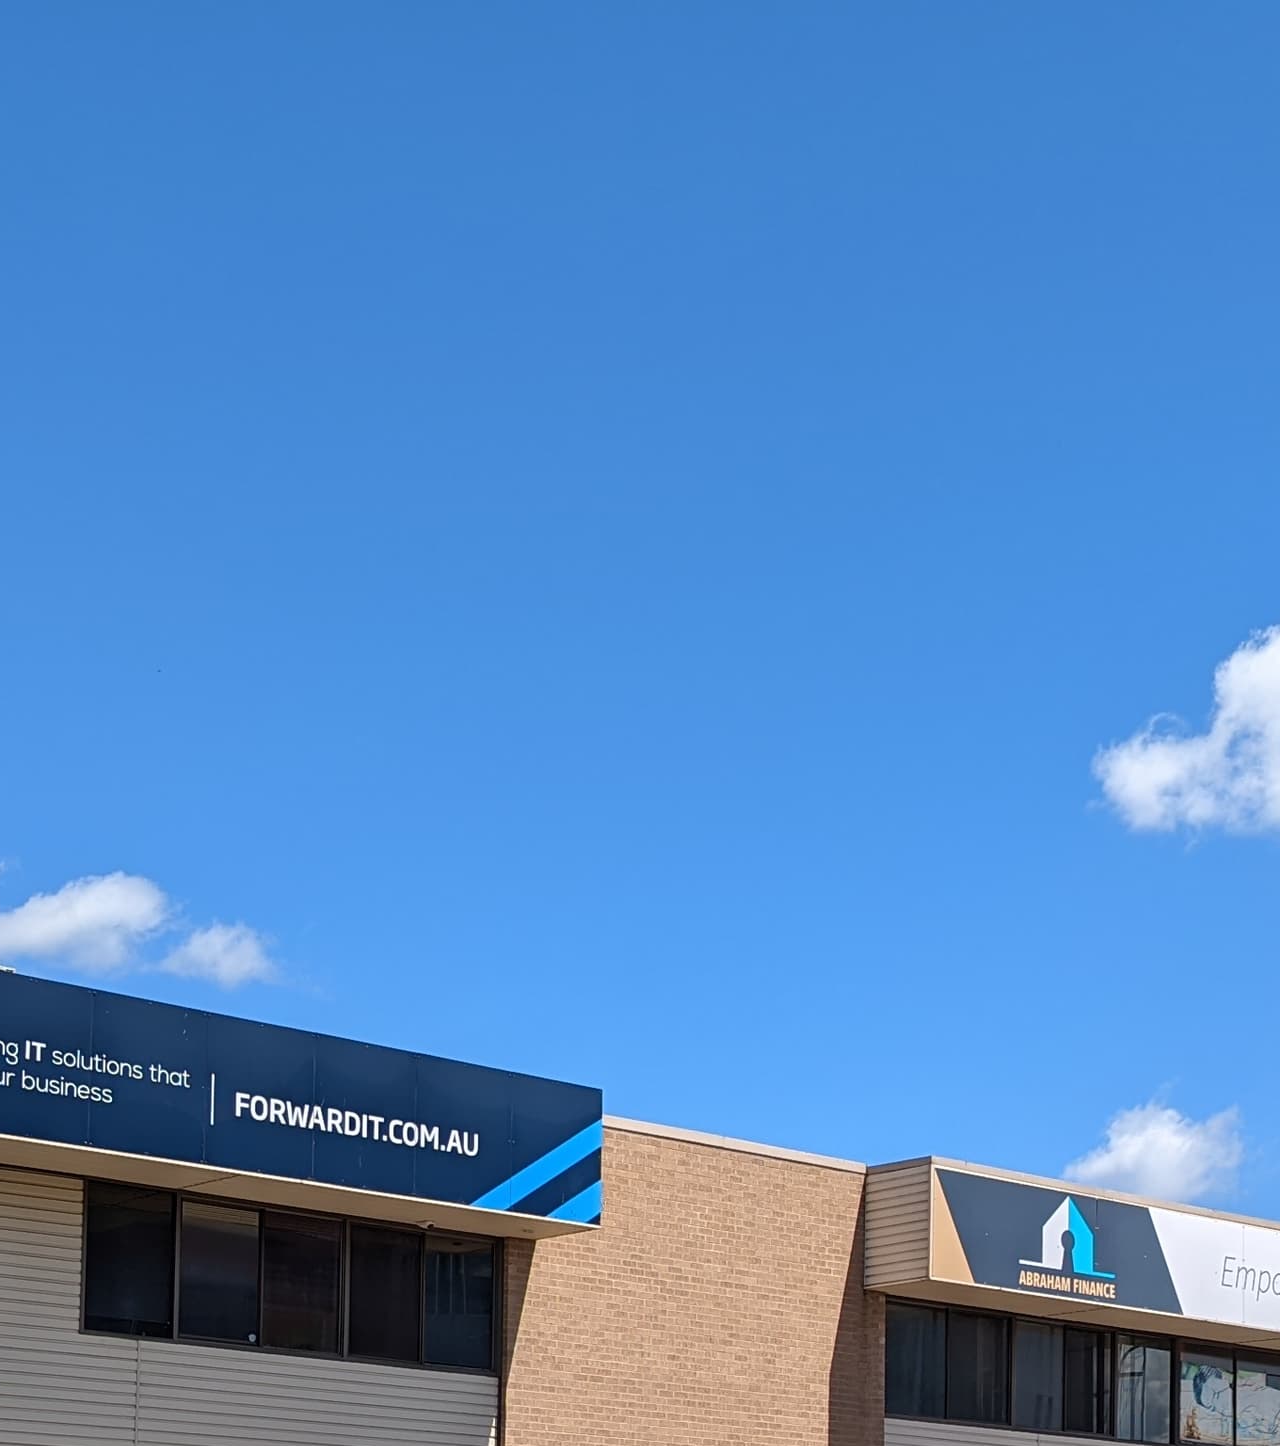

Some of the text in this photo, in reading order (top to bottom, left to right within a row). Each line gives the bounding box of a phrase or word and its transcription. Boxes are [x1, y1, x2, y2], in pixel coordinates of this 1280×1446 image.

[24, 1040, 47, 1062] IT
[52, 1050, 144, 1080] solutions
[149, 1064, 192, 1089] that
[21, 1070, 113, 1104] business
[234, 1091, 480, 1157] FORWARDIT.COM.AU
[1019, 1270, 1116, 1299] ABRAHAM FINANCE
